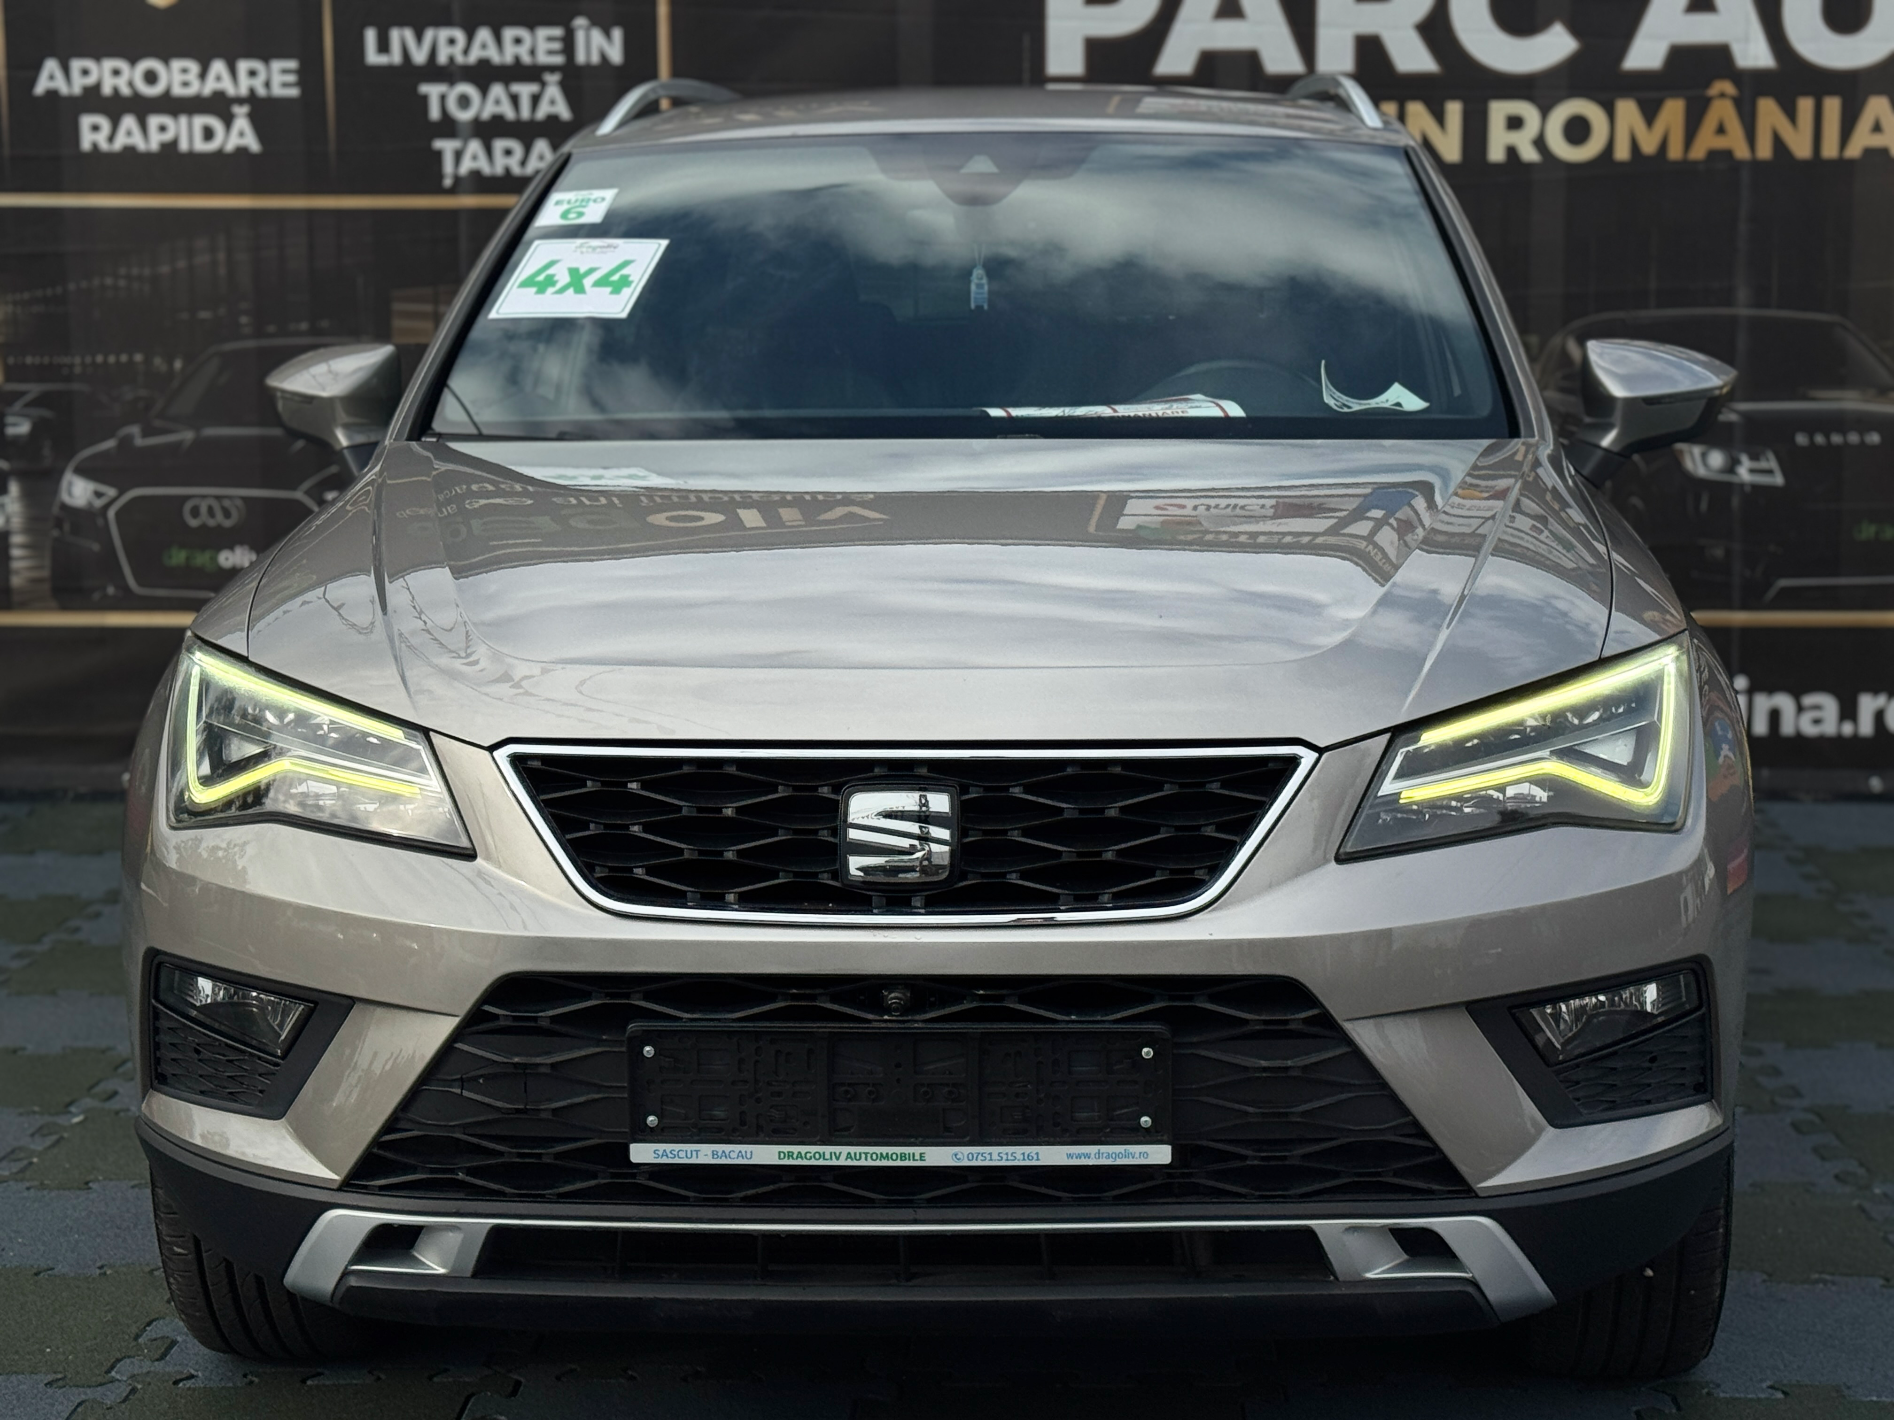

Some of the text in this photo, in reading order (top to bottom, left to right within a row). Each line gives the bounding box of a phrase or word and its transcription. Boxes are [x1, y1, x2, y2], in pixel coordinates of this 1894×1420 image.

[364, 15, 624, 66] LIVRARE ÎN
[1045, 0, 1582, 76] PARC
[33, 58, 300, 98] APROBARE
[418, 73, 573, 122] TOATĂ
[78, 104, 262, 153] RAPIDĂ
[1378, 78, 1894, 164] N ROMÂNIA
[553, 196, 606, 206] EURO
[560, 204, 587, 221] 6
[1733, 673, 1894, 738] ina.r
[653, 1148, 700, 1160] SASCUT
[711, 1149, 753, 1160] BACAU
[777, 1150, 927, 1163] DRAGOLIV AUTOMOBILE
[966, 1150, 1041, 1162] 0751.515.161
[1065, 1148, 1149, 1163] www.dragoliv.ro
